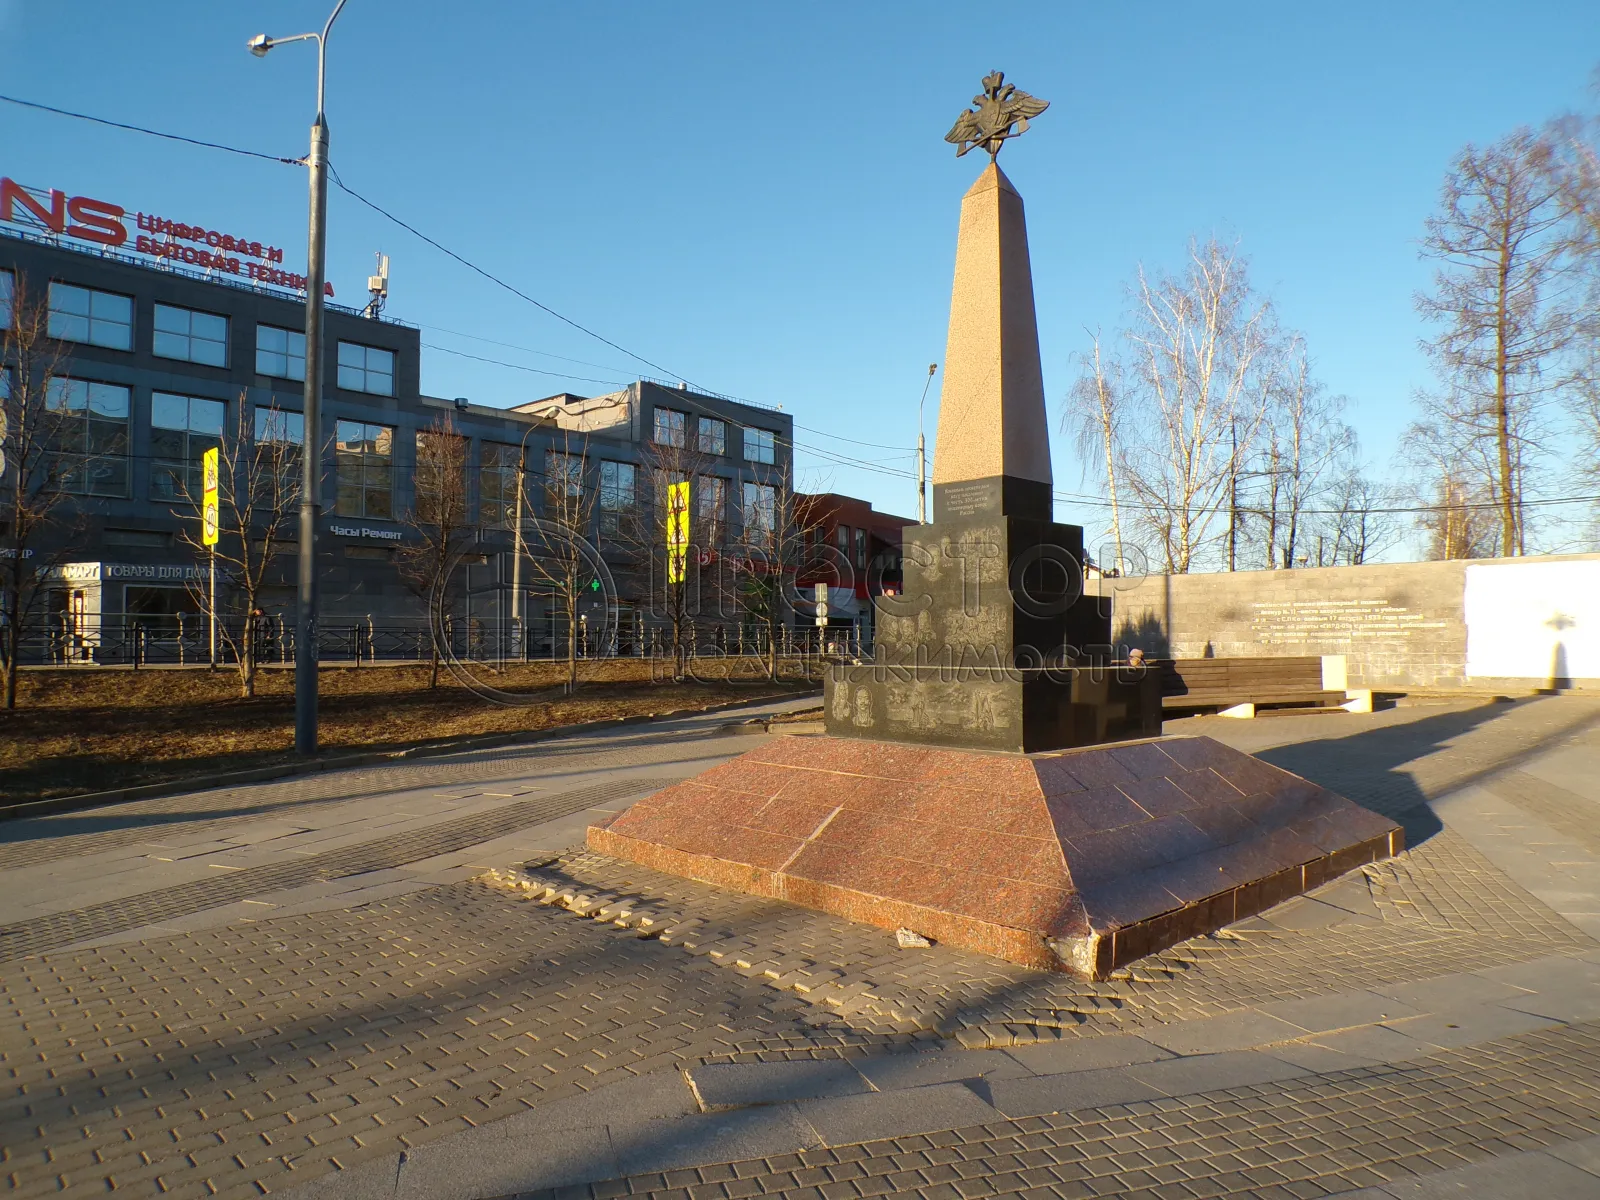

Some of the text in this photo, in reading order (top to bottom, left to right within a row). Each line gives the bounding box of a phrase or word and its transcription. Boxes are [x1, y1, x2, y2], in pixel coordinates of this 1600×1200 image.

[137, 211, 283, 263] ЦИФРОВАЯ И
[136, 235, 335, 297] БЫТОВАЯ ТЕХНИА
[329, 525, 402, 540] Часы Ремонт
[105, 565, 155, 578] ТОВАРЫ
[158, 566, 182, 579] ДЛЯ
